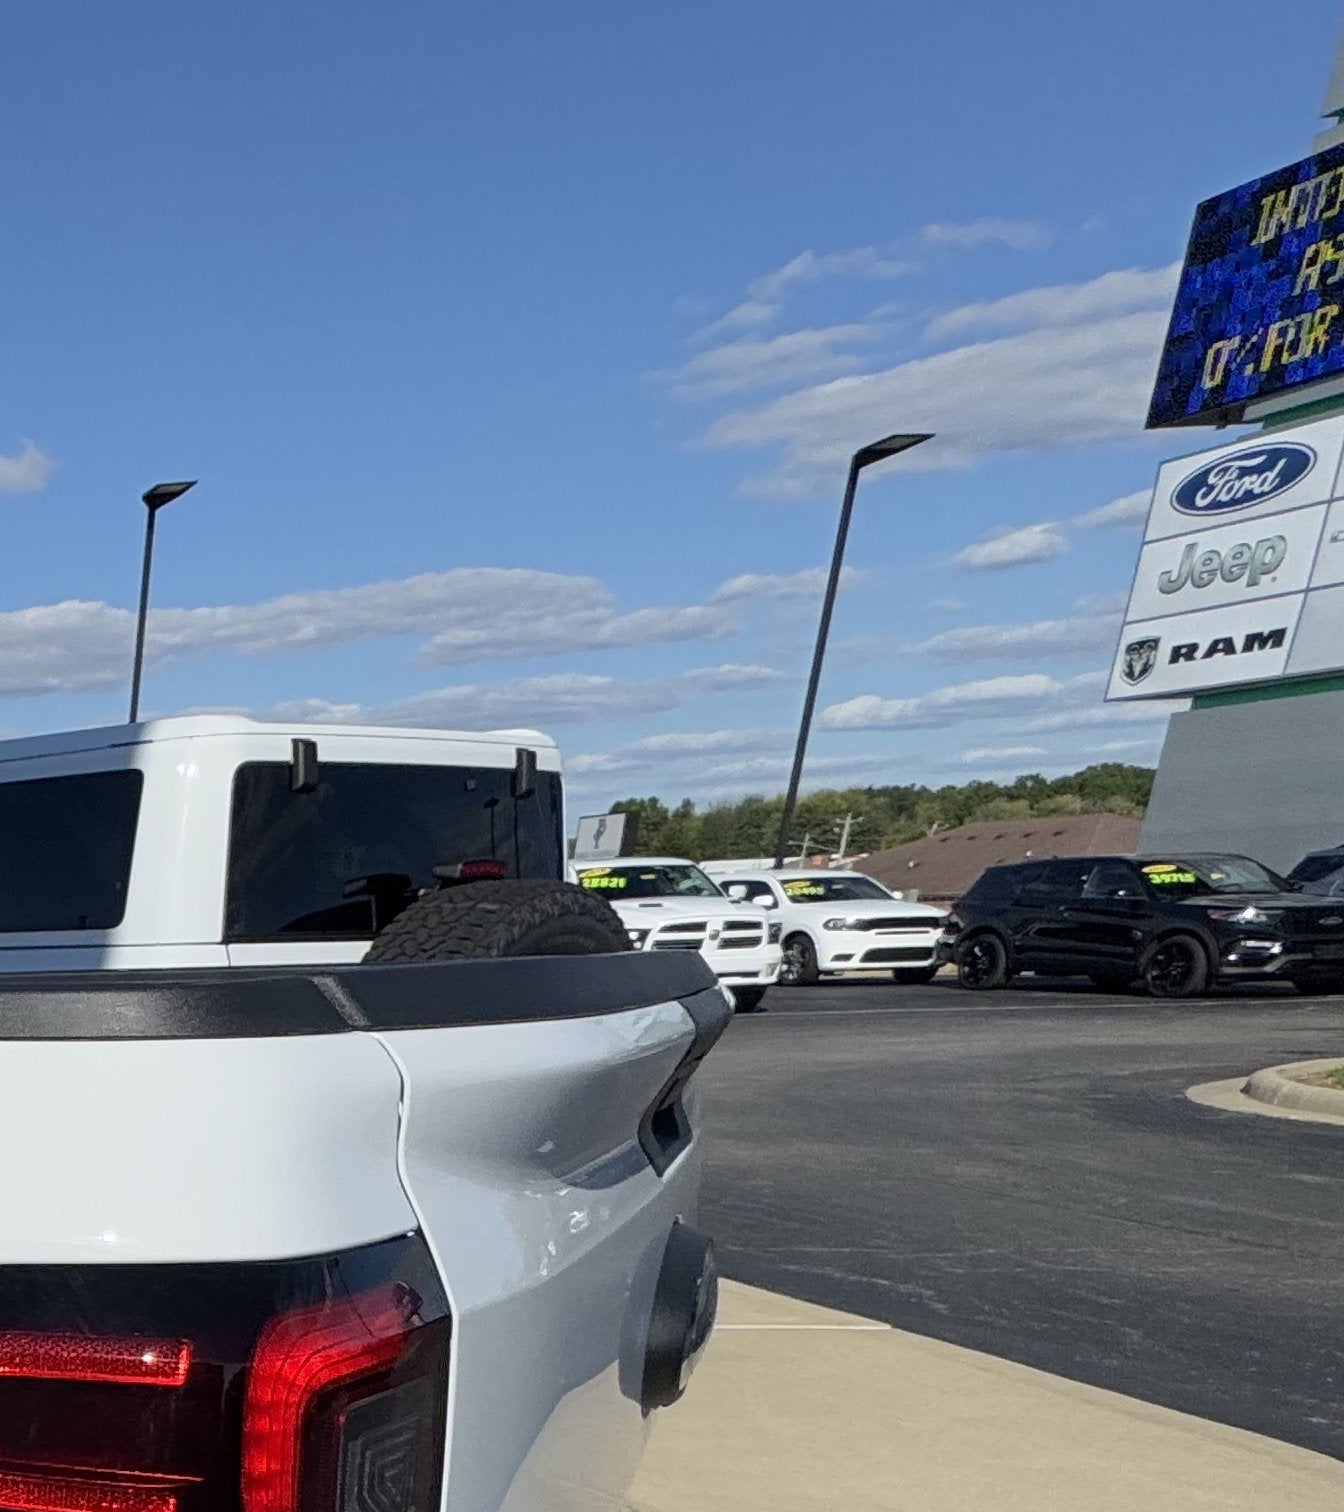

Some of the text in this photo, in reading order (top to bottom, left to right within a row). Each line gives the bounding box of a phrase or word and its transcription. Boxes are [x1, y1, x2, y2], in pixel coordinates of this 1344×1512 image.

[1195, 455, 1286, 508] Ford
[1158, 534, 1287, 595] Jeep
[1168, 627, 1288, 665] RAM
